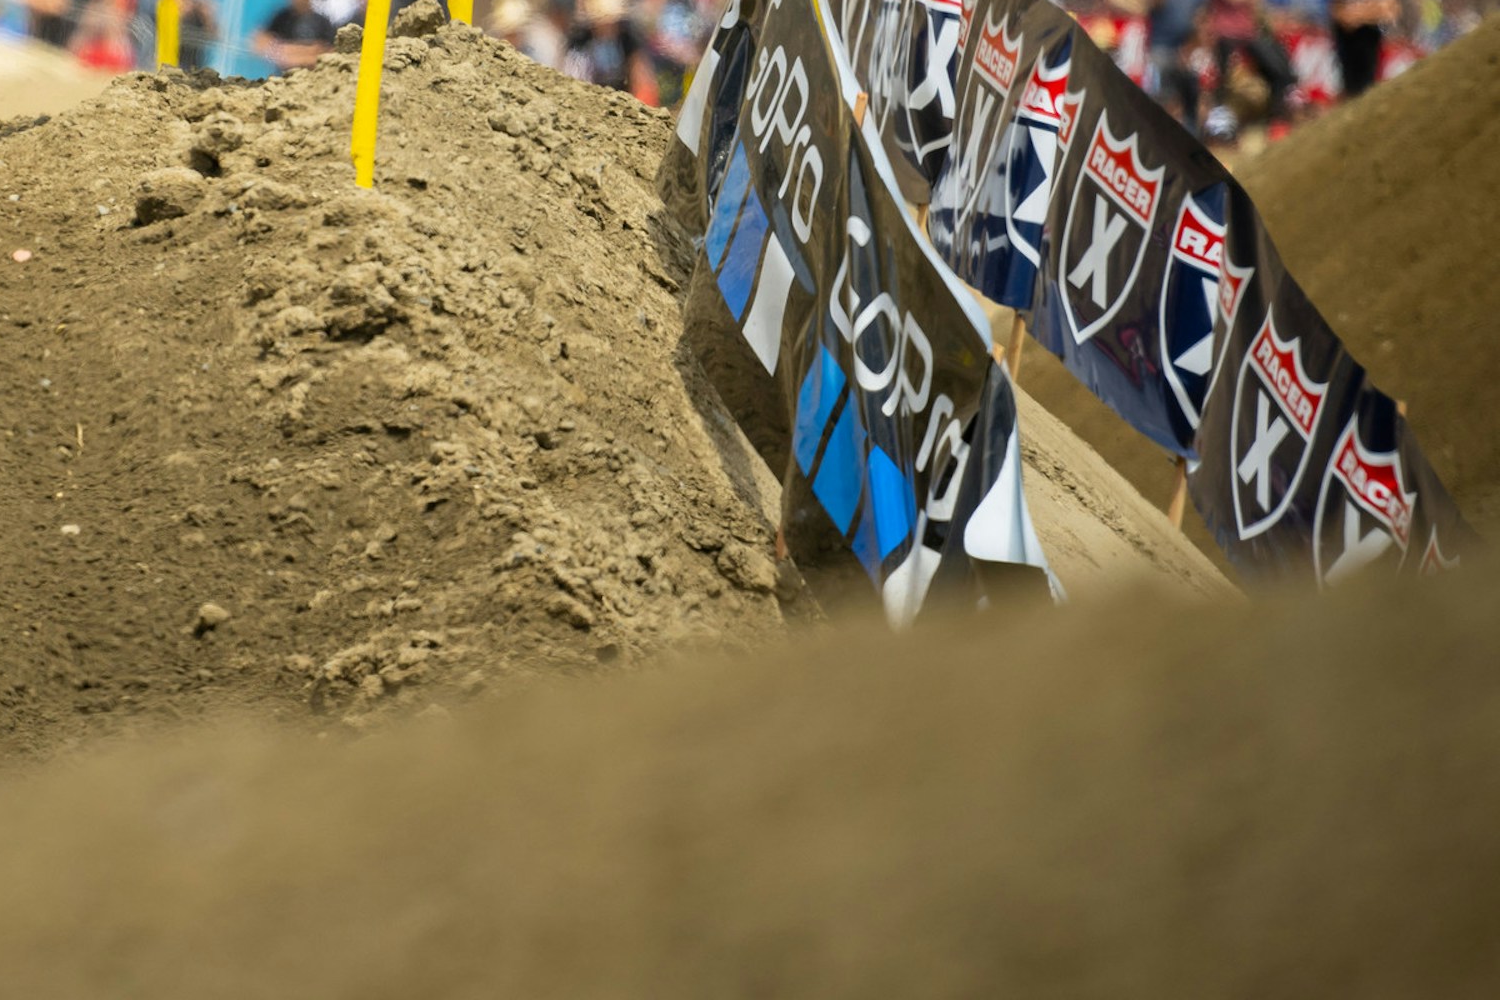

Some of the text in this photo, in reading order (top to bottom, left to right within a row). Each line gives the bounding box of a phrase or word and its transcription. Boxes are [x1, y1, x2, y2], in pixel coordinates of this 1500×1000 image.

[976, 41, 1013, 86] RACER
[960, 84, 996, 190] X
[1092, 150, 1152, 216] RACER
[1067, 193, 1129, 310] X
[1257, 339, 1314, 425] RACER
[1237, 389, 1290, 513] X
